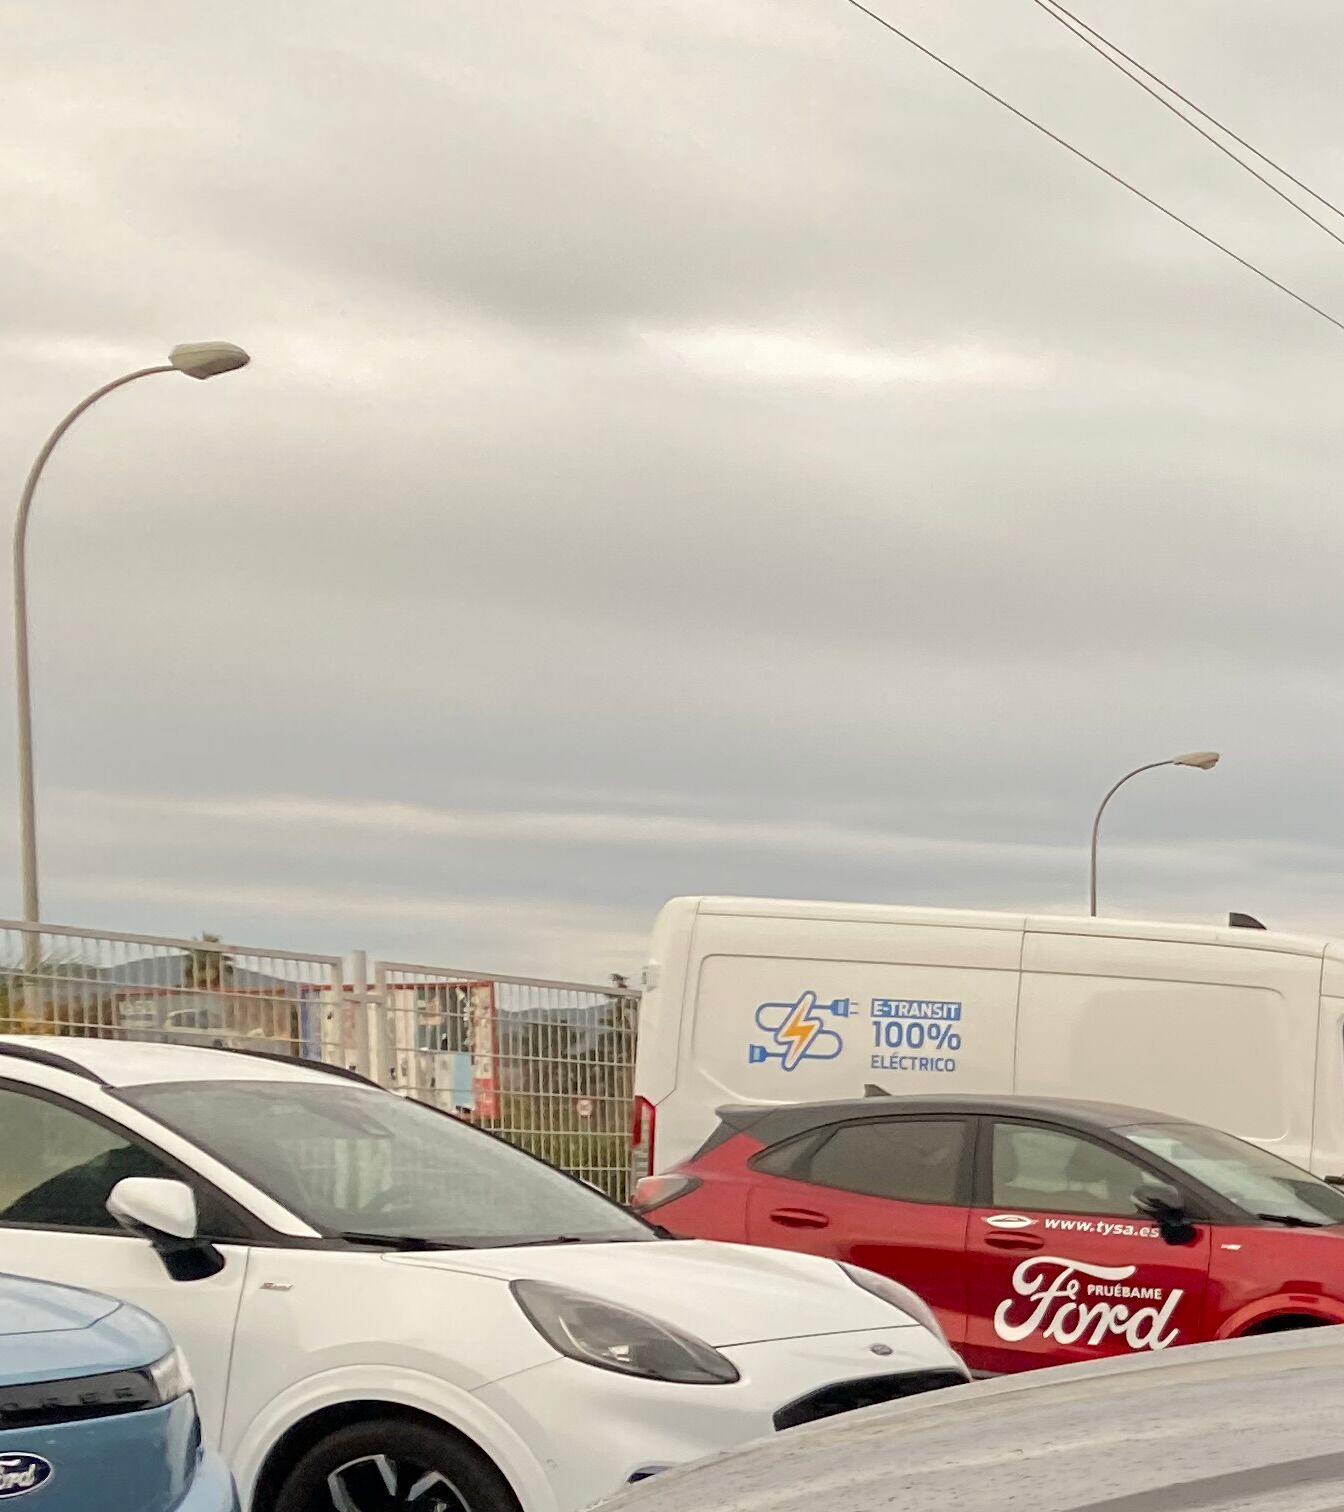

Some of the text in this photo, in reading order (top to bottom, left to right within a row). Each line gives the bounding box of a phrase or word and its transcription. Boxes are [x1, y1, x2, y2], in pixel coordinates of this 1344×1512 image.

[872, 1000, 959, 1019] E-TRANSIT
[872, 1020, 961, 1051] 100%
[871, 1052, 956, 1072] ELÉCTRICO
[1044, 1218, 1160, 1239] www.tysa.es
[1087, 1282, 1163, 1301] PRUÉBAME
[994, 1255, 1184, 1351] Ford
